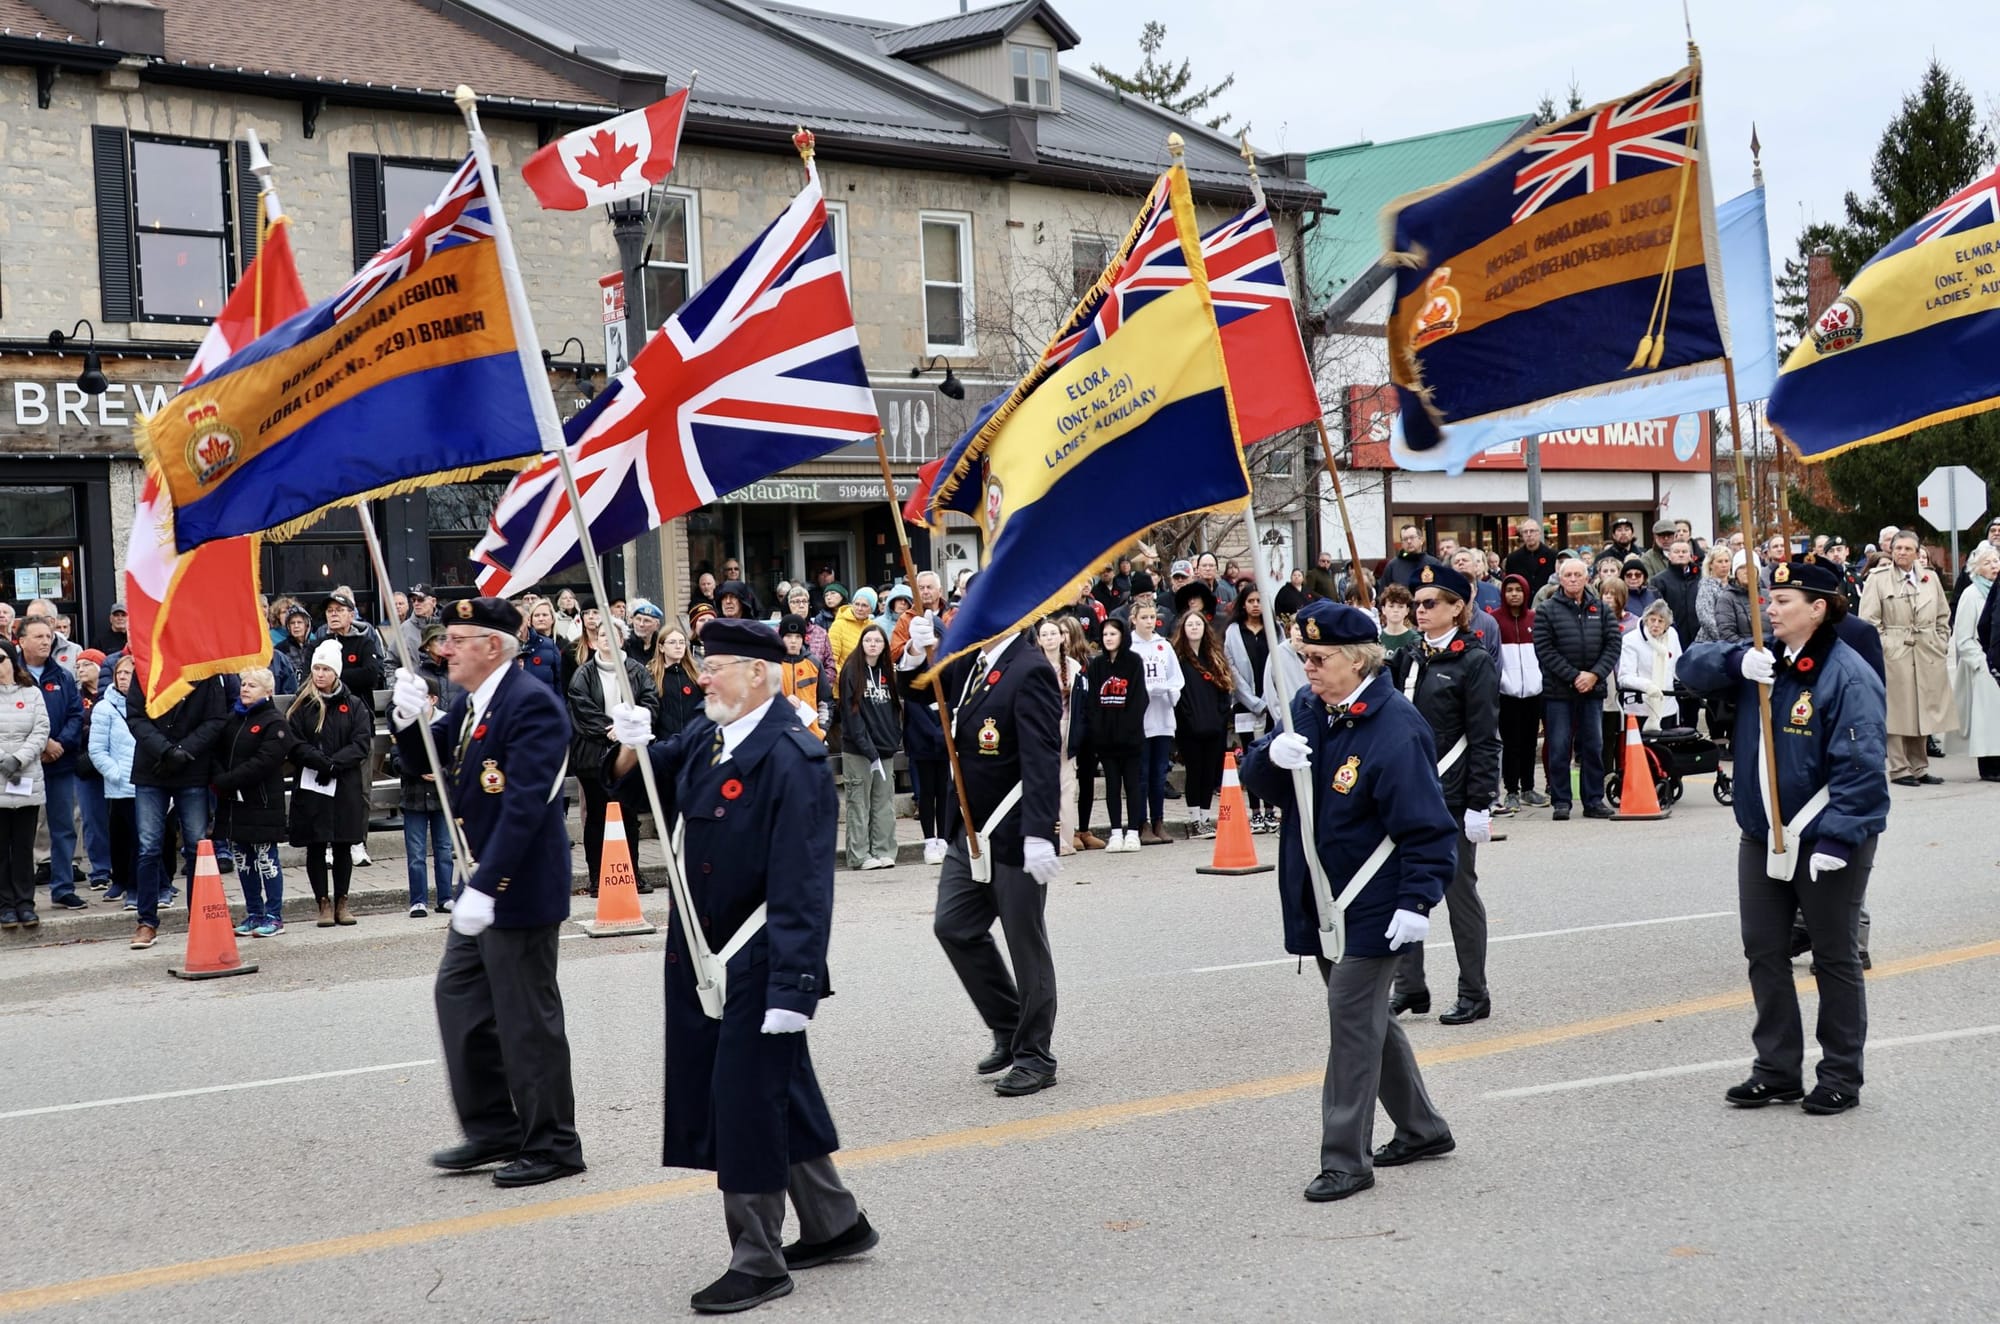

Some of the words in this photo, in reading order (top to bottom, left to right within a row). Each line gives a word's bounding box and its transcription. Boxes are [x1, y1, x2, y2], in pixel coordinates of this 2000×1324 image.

[1975, 263, 1996, 277] NO.
[398, 273, 458, 311] LEGION
[1926, 283, 1973, 311] LADIES'
[1981, 280, 2000, 296] AU
[1818, 327, 1859, 346] LEGION
[258, 396, 302, 436] ELORA
[417, 310, 486, 344] BRANCH
[1066, 366, 1111, 401] ELORA
[1108, 372, 1134, 403] 229)
[1094, 385, 1157, 433] AUXILIARY
[1604, 420, 1668, 447] MART
[610, 863, 629, 873] TCW
